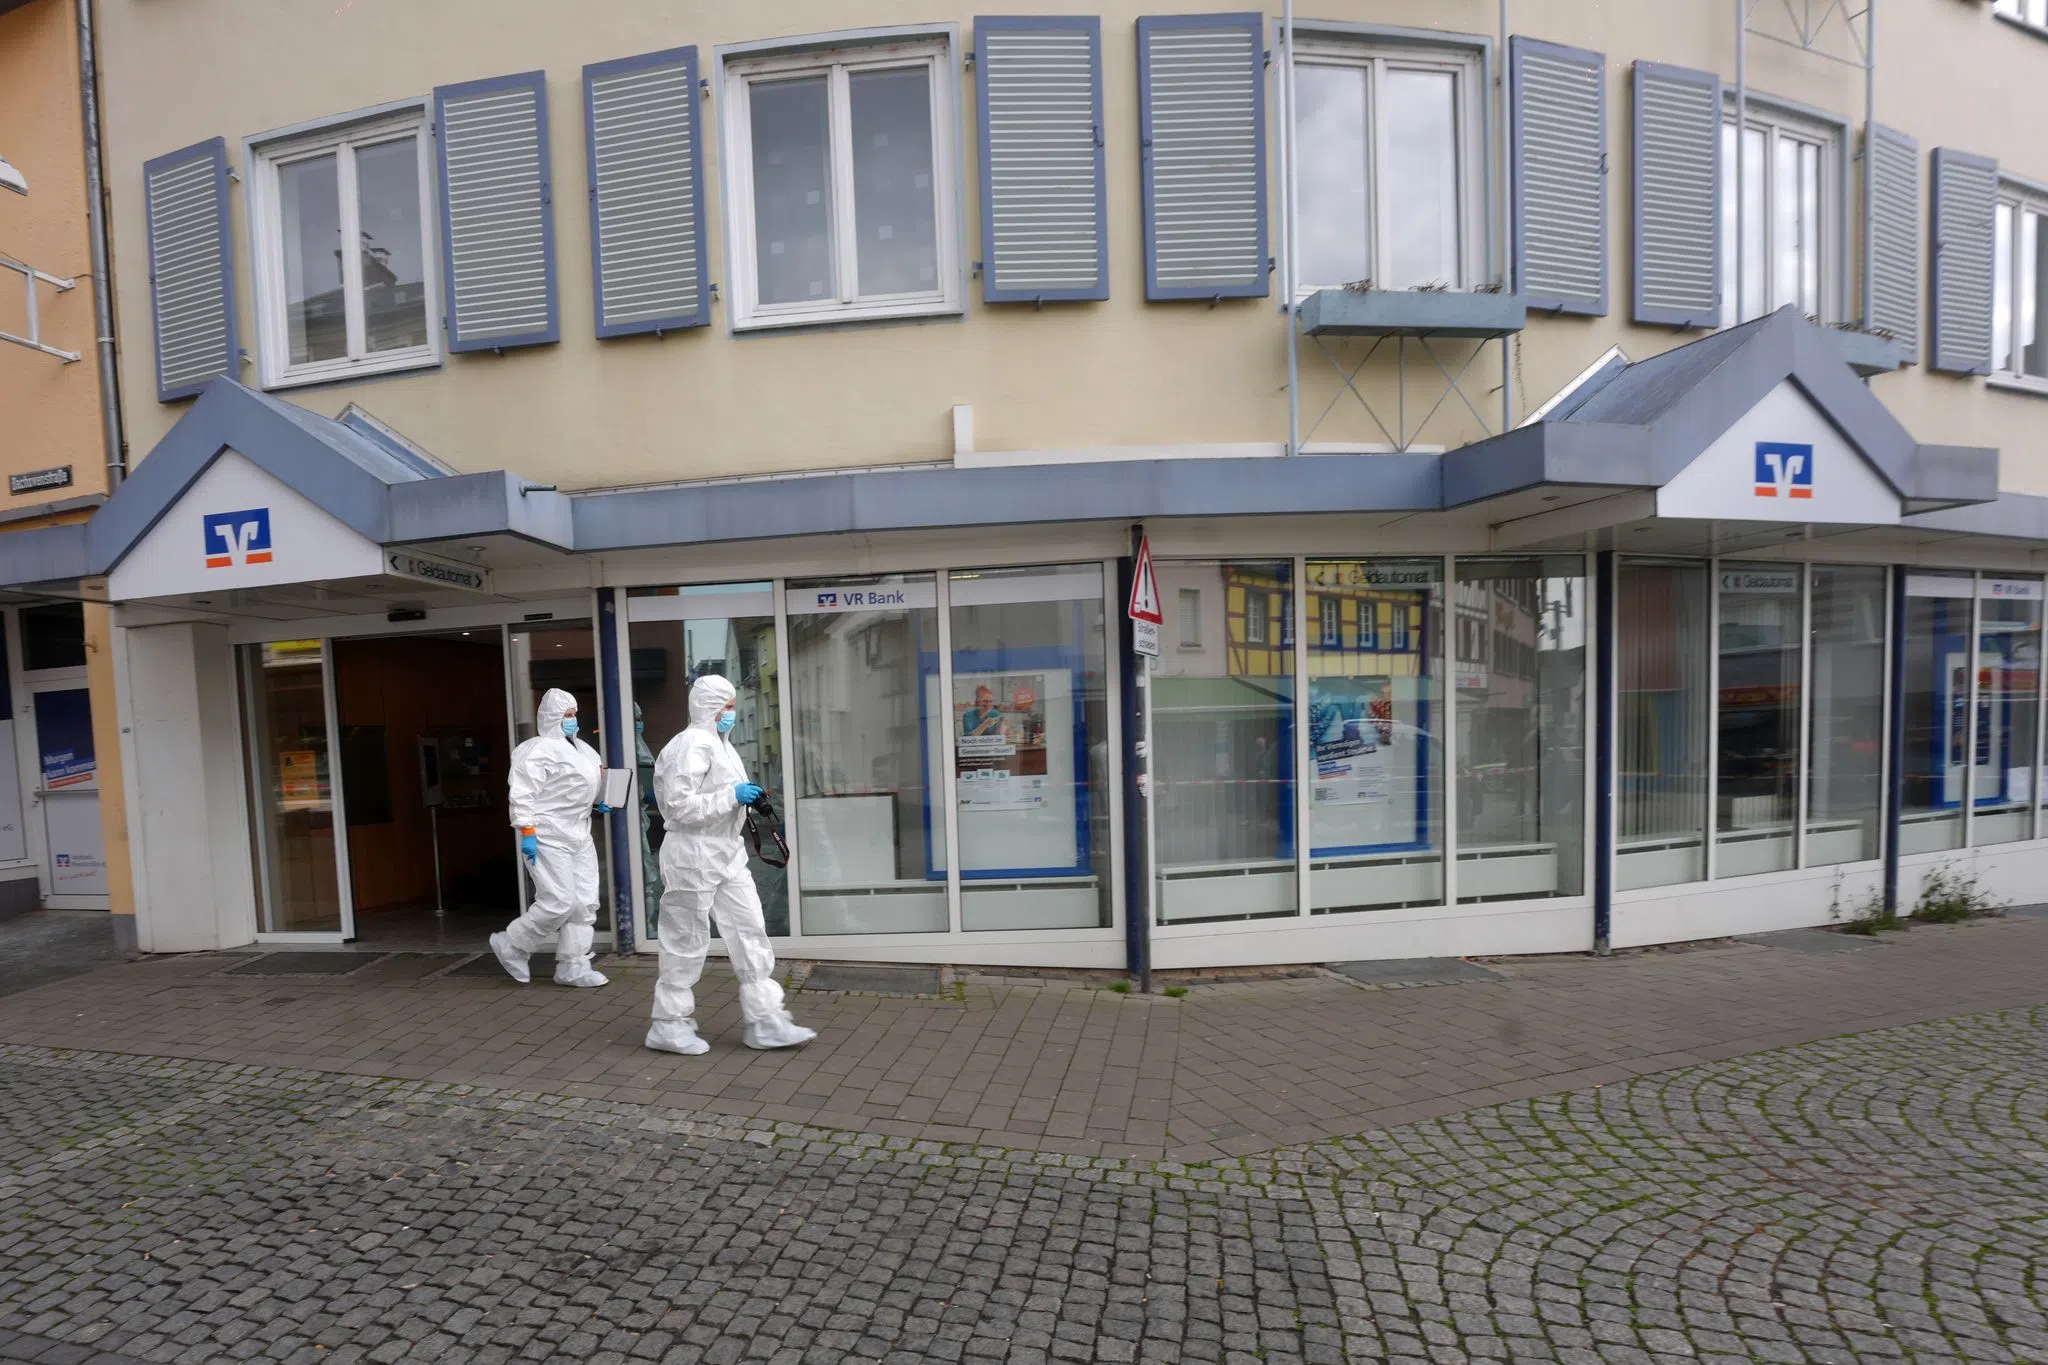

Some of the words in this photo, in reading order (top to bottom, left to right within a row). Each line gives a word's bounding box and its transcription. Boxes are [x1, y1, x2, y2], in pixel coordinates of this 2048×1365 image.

[416, 560, 473, 586] Geldautomat
[1349, 569, 1429, 584] Geldautomat
[843, 593, 864, 606] VR
[868, 589, 905, 605] Bank
[44, 752, 75, 765] Morgen
